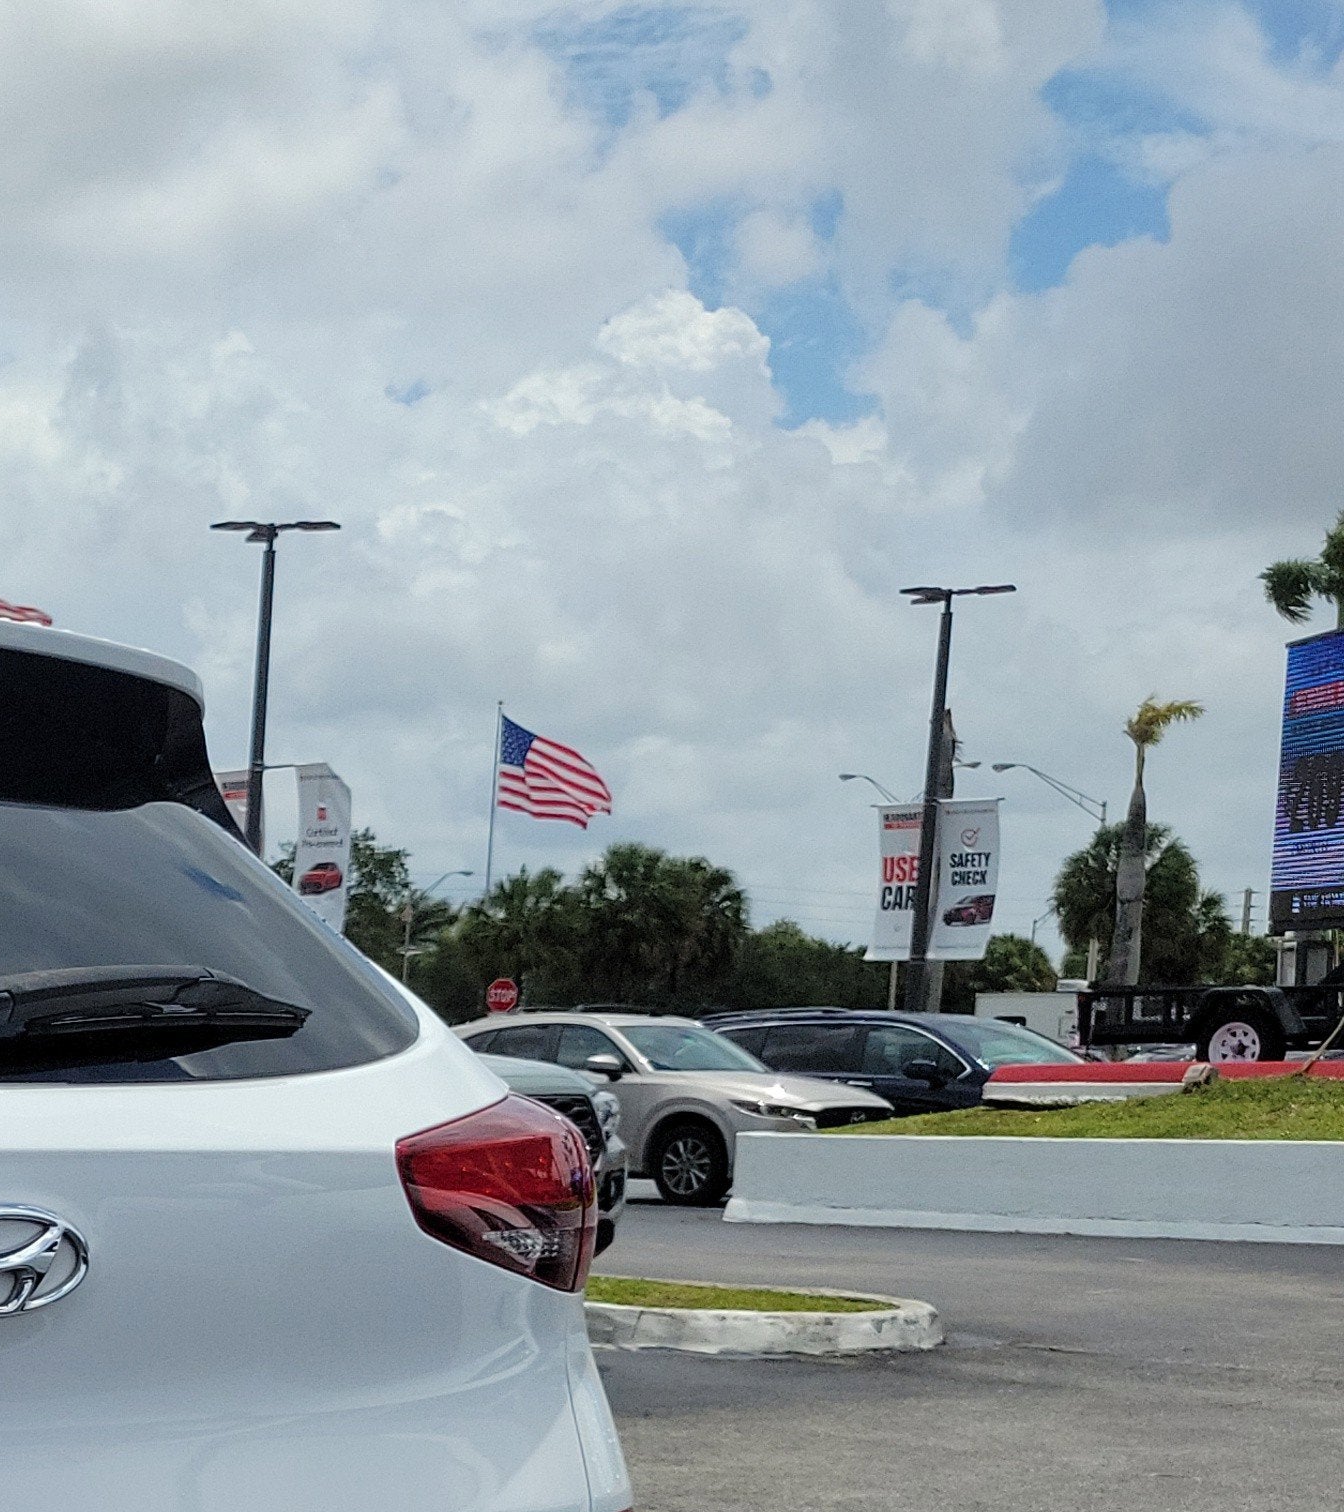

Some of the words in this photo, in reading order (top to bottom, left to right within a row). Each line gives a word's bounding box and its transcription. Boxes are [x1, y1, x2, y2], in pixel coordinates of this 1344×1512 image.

[949, 852, 992, 869] SAFETY
[883, 856, 919, 883] USE
[950, 869, 988, 886] CHECK
[880, 885, 916, 911] CAR
[489, 989, 516, 1002] STOP
